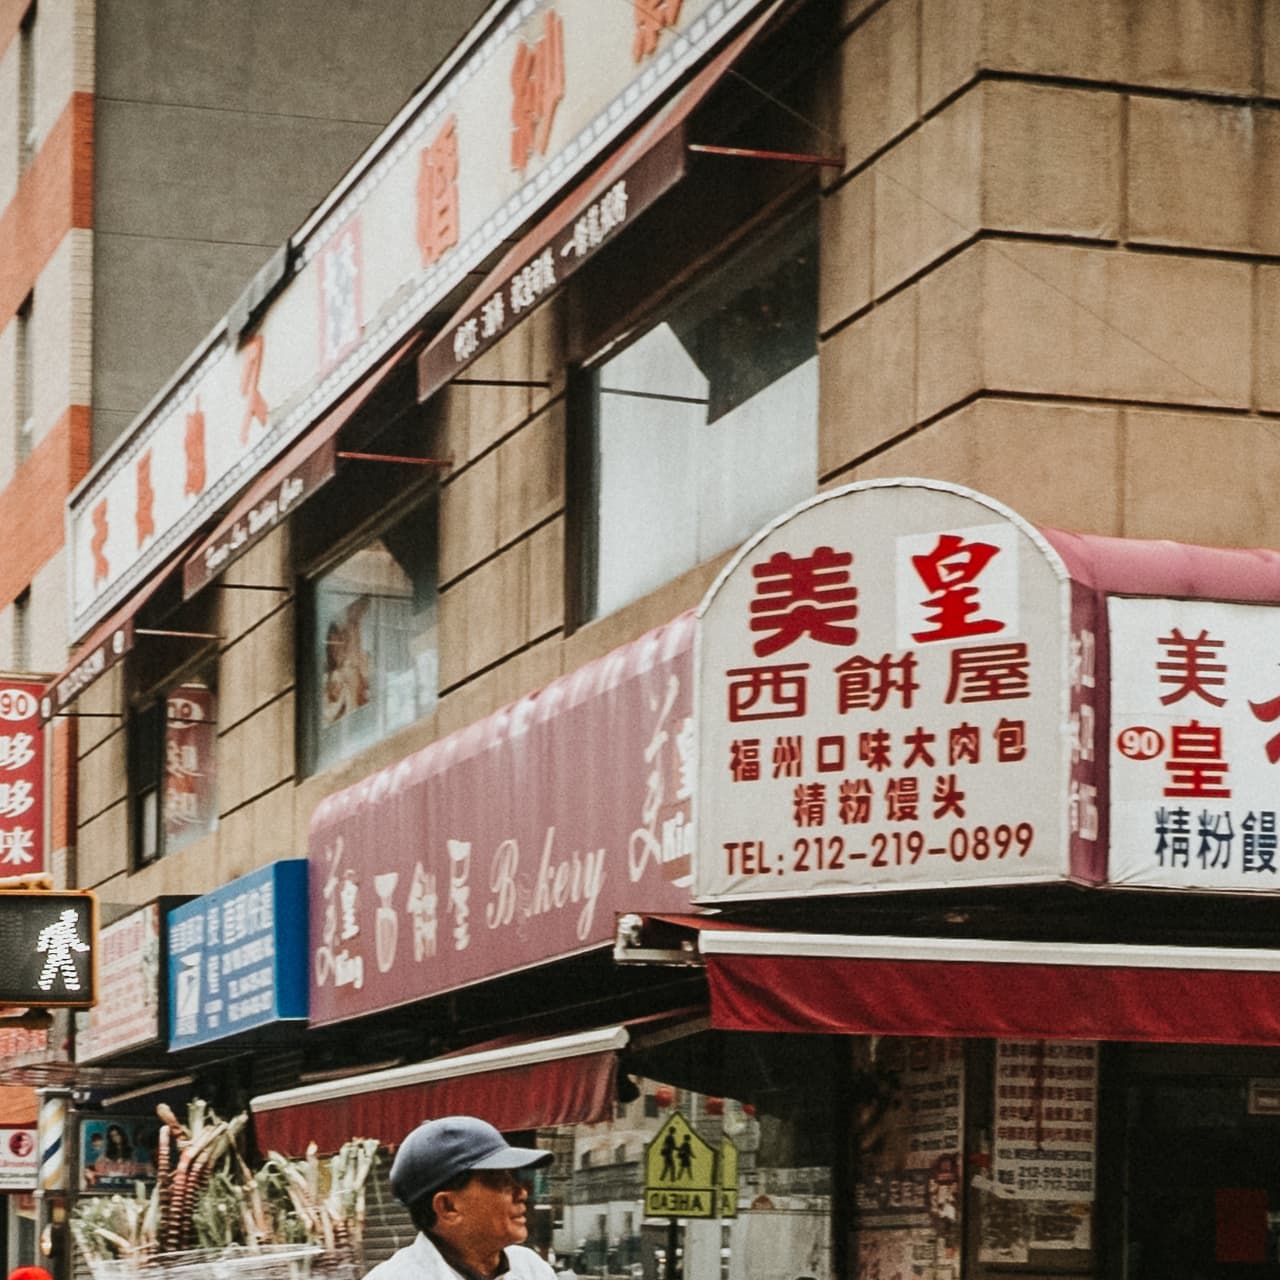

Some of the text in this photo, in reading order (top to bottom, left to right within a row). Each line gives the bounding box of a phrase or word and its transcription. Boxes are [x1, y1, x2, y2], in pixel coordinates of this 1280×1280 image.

[749, 534, 1008, 658] 美皇
[0, 694, 29, 716] 90
[726, 642, 1031, 723] 西餅屋
[1155, 627, 1233, 800] 美皇
[729, 718, 1028, 783] 福州口味大肉包
[1122, 731, 1162, 757] 90
[792, 774, 966, 828] 精粉馒头
